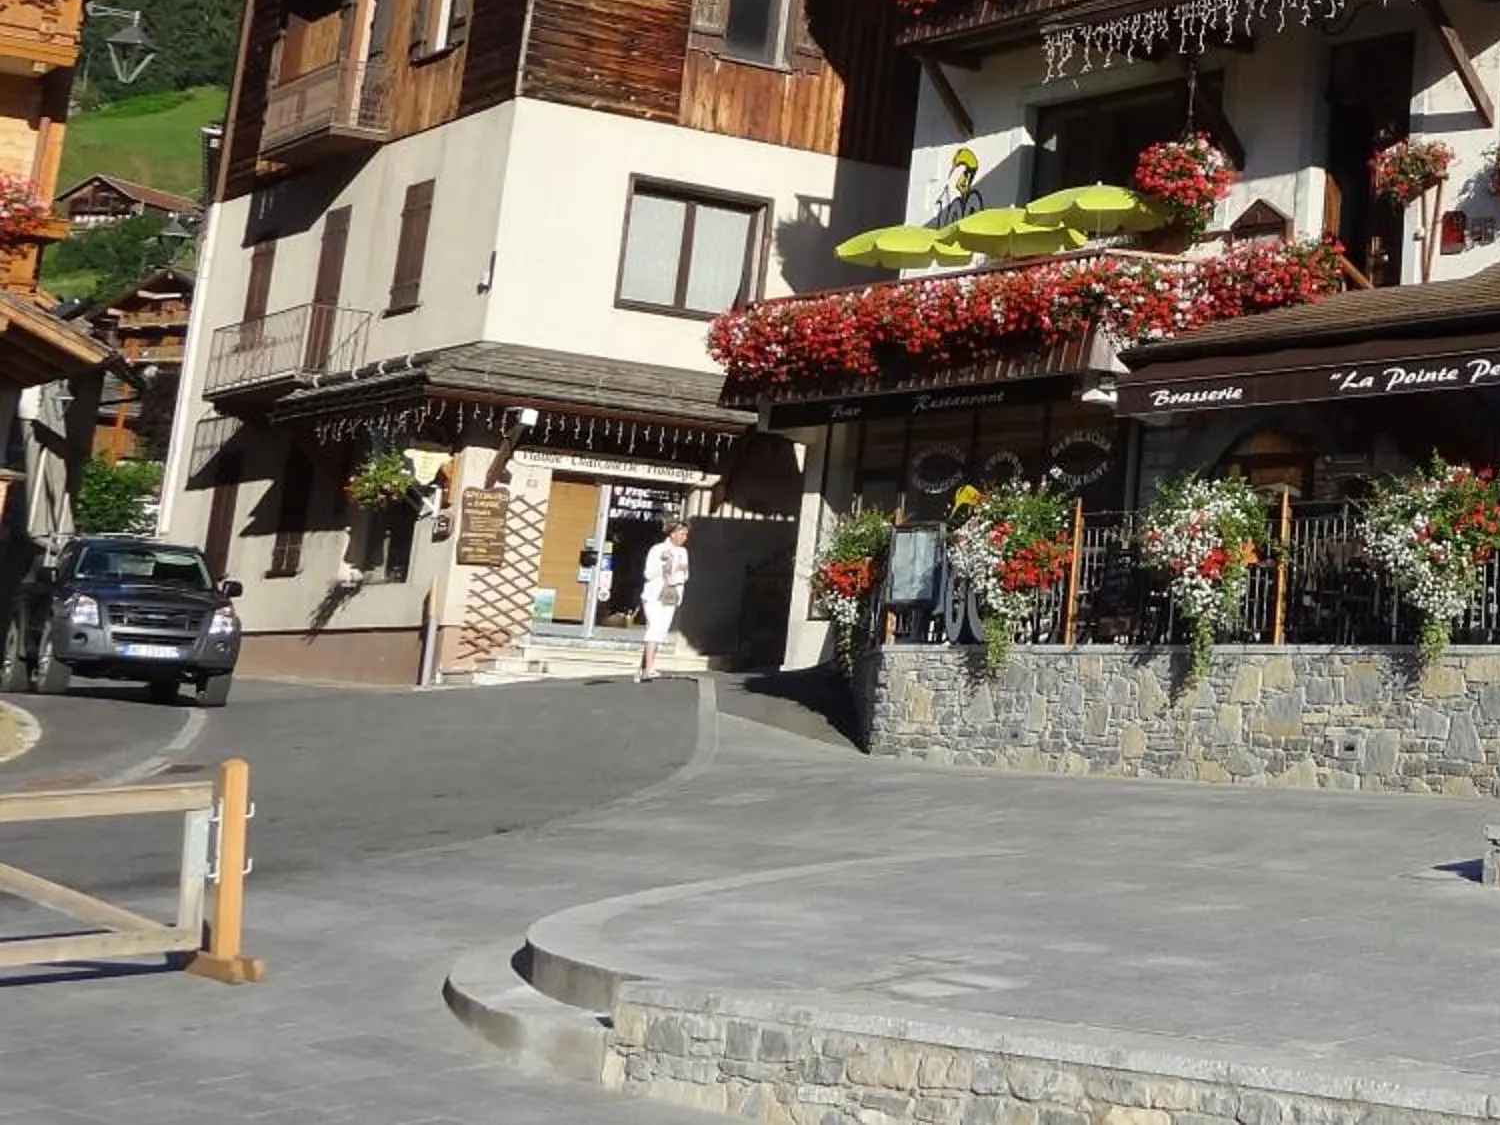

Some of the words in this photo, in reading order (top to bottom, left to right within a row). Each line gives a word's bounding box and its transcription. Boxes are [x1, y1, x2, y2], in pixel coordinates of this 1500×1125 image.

[1383, 365, 1460, 392] Pointe
[829, 403, 862, 419] Bar
[911, 391, 1005, 414] Restaurant
[1150, 385, 1244, 408] Brasserie
